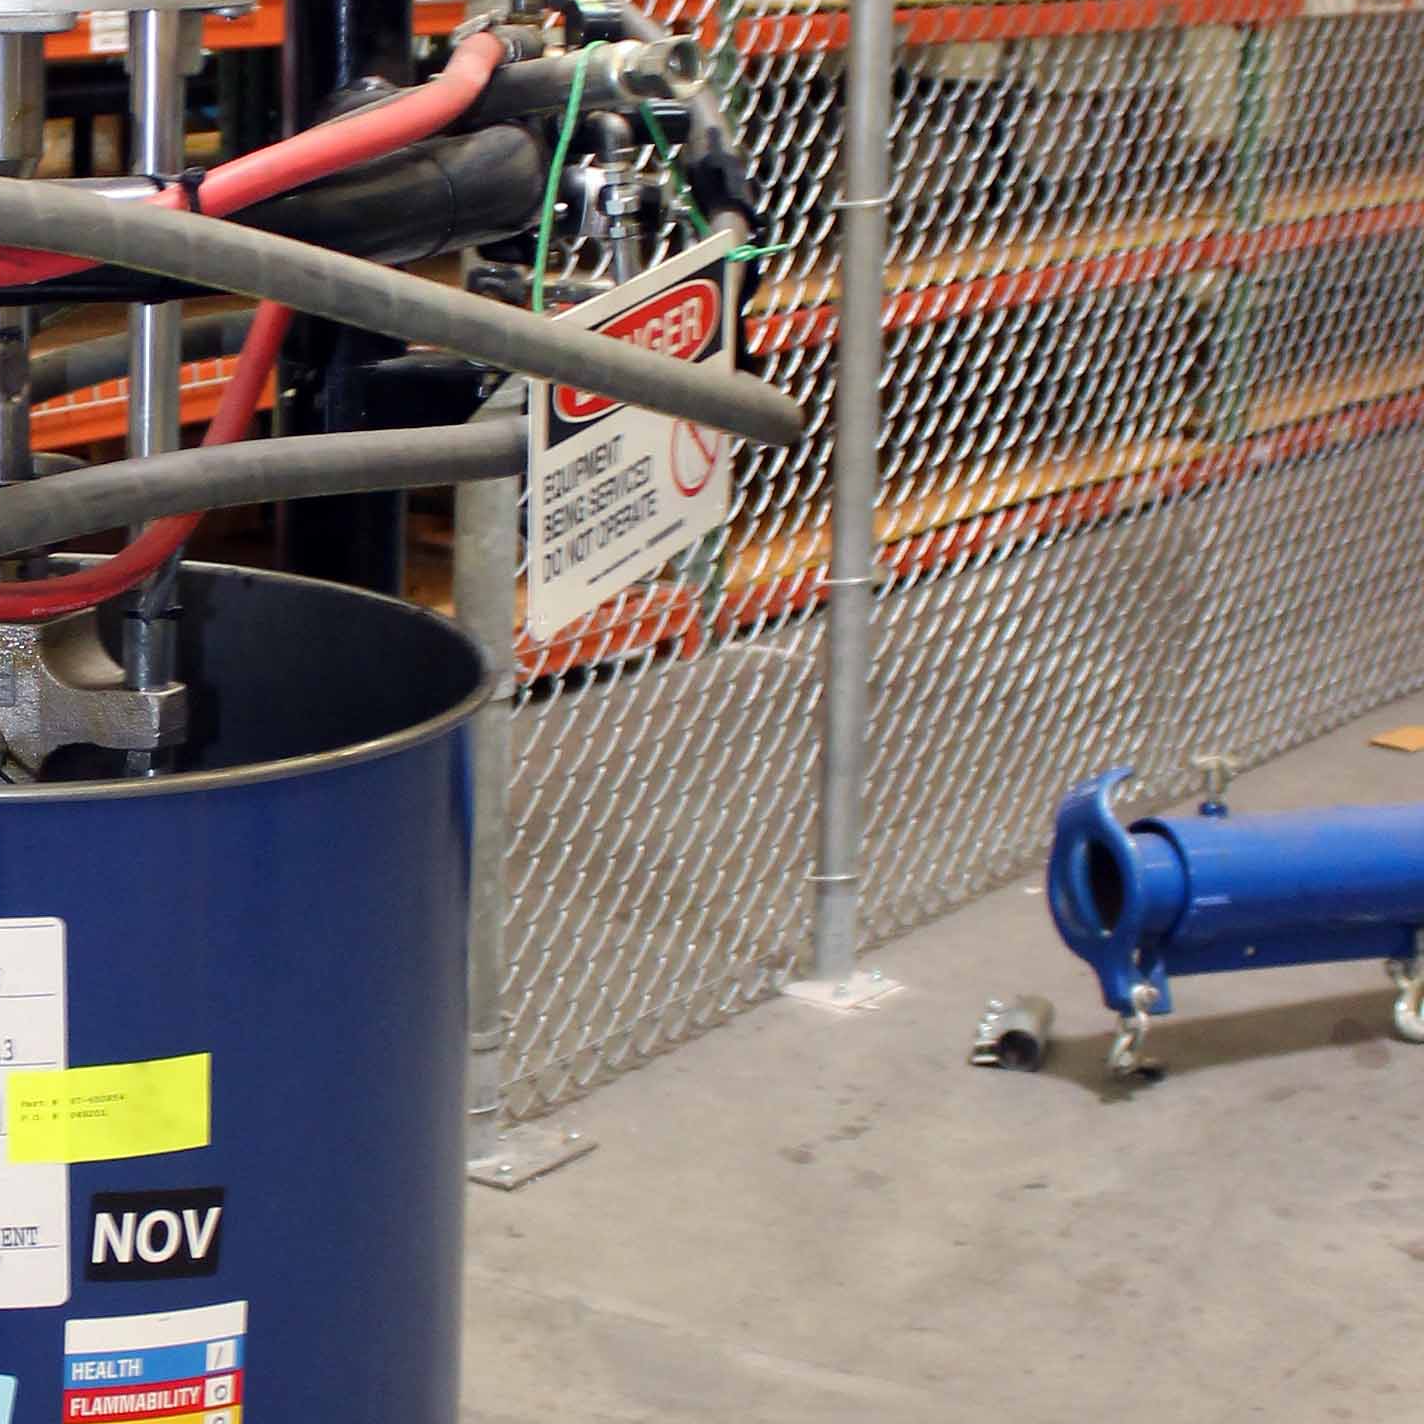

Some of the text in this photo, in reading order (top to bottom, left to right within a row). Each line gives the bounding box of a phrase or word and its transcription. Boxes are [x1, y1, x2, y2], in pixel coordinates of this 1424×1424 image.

[91, 1207, 223, 1264] NOV
[71, 1357, 144, 1381] HEALTH
[70, 1385, 201, 1418] FLAMMABILITY
